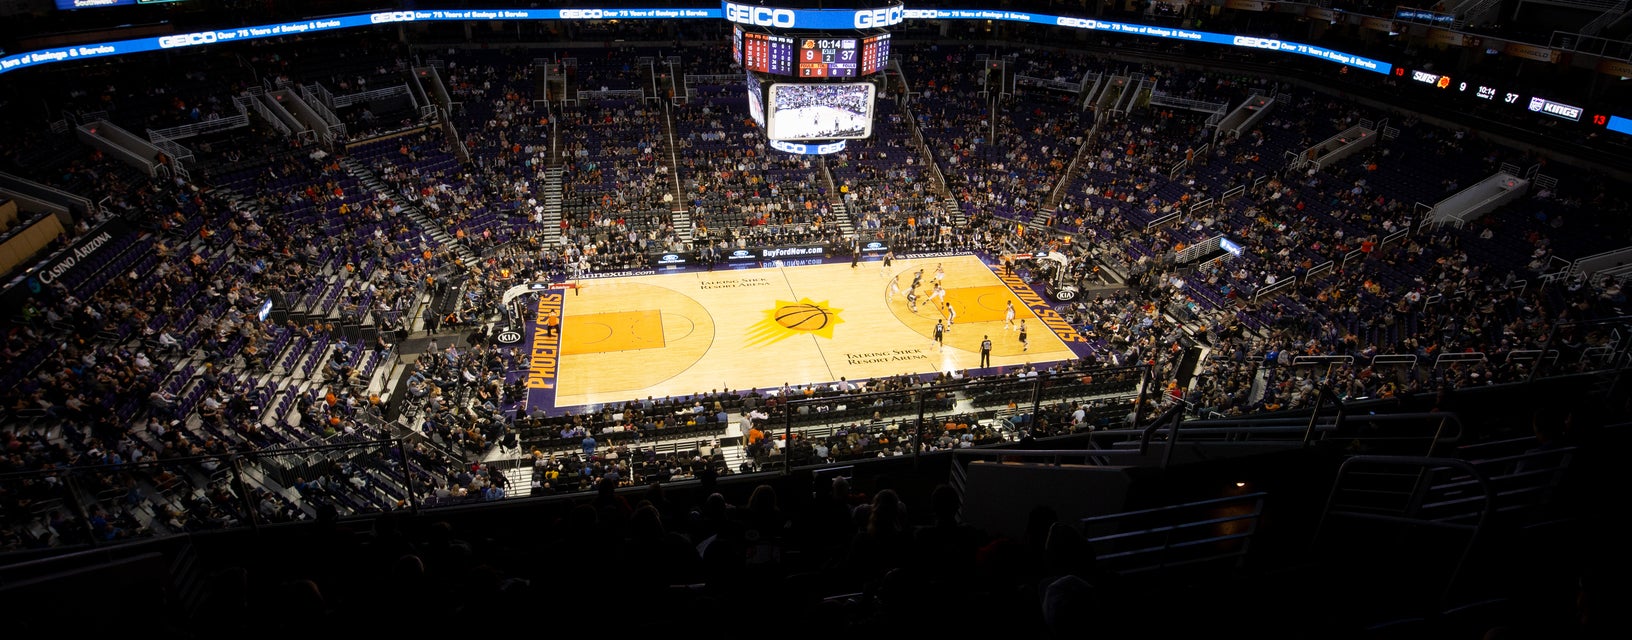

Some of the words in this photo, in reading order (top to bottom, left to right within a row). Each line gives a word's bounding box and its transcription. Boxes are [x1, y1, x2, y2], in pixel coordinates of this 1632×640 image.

[371, 11, 415, 23] GEICO
[560, 10, 602, 18] GEICO
[726, 3, 795, 28] GEICO
[1057, 17, 1096, 28] GEICO
[1147, 28, 1170, 36] Savings
[159, 31, 217, 48] GEICO
[218, 28, 236, 40] Over
[238, 28, 249, 37] 75
[250, 26, 271, 36] Years
[282, 23, 308, 33] Savings
[316, 20, 340, 28] Service
[818, 40, 841, 48] 10:14
[21, 55, 31, 64] of
[31, 52, 68, 61] Savings
[79, 46, 115, 55] Service
[806, 50, 814, 60] 9
[841, 50, 854, 60] 37
[1234, 36, 1280, 50] GEICO
[1308, 47, 1322, 55] Years
[1329, 52, 1349, 63] Savings
[1356, 58, 1376, 69] Service
[1395, 68, 1405, 76] 13
[1413, 71, 1437, 84] SUNS
[1459, 82, 1467, 91] 9
[1479, 86, 1496, 96] 10:14
[1505, 93, 1519, 104] 37
[1544, 102, 1580, 118] KINGS
[1593, 114, 1606, 125] 13
[38, 257, 76, 285] CASINO
[73, 231, 112, 261] ARIZONA
[763, 248, 822, 257] BuyFordNow.com
[578, 270, 655, 278] annexus.com
[536, 293, 562, 326] SUNS
[1034, 309, 1087, 342] SUNS
[501, 333, 517, 342] KIA
[528, 327, 559, 389] PHOENIX
